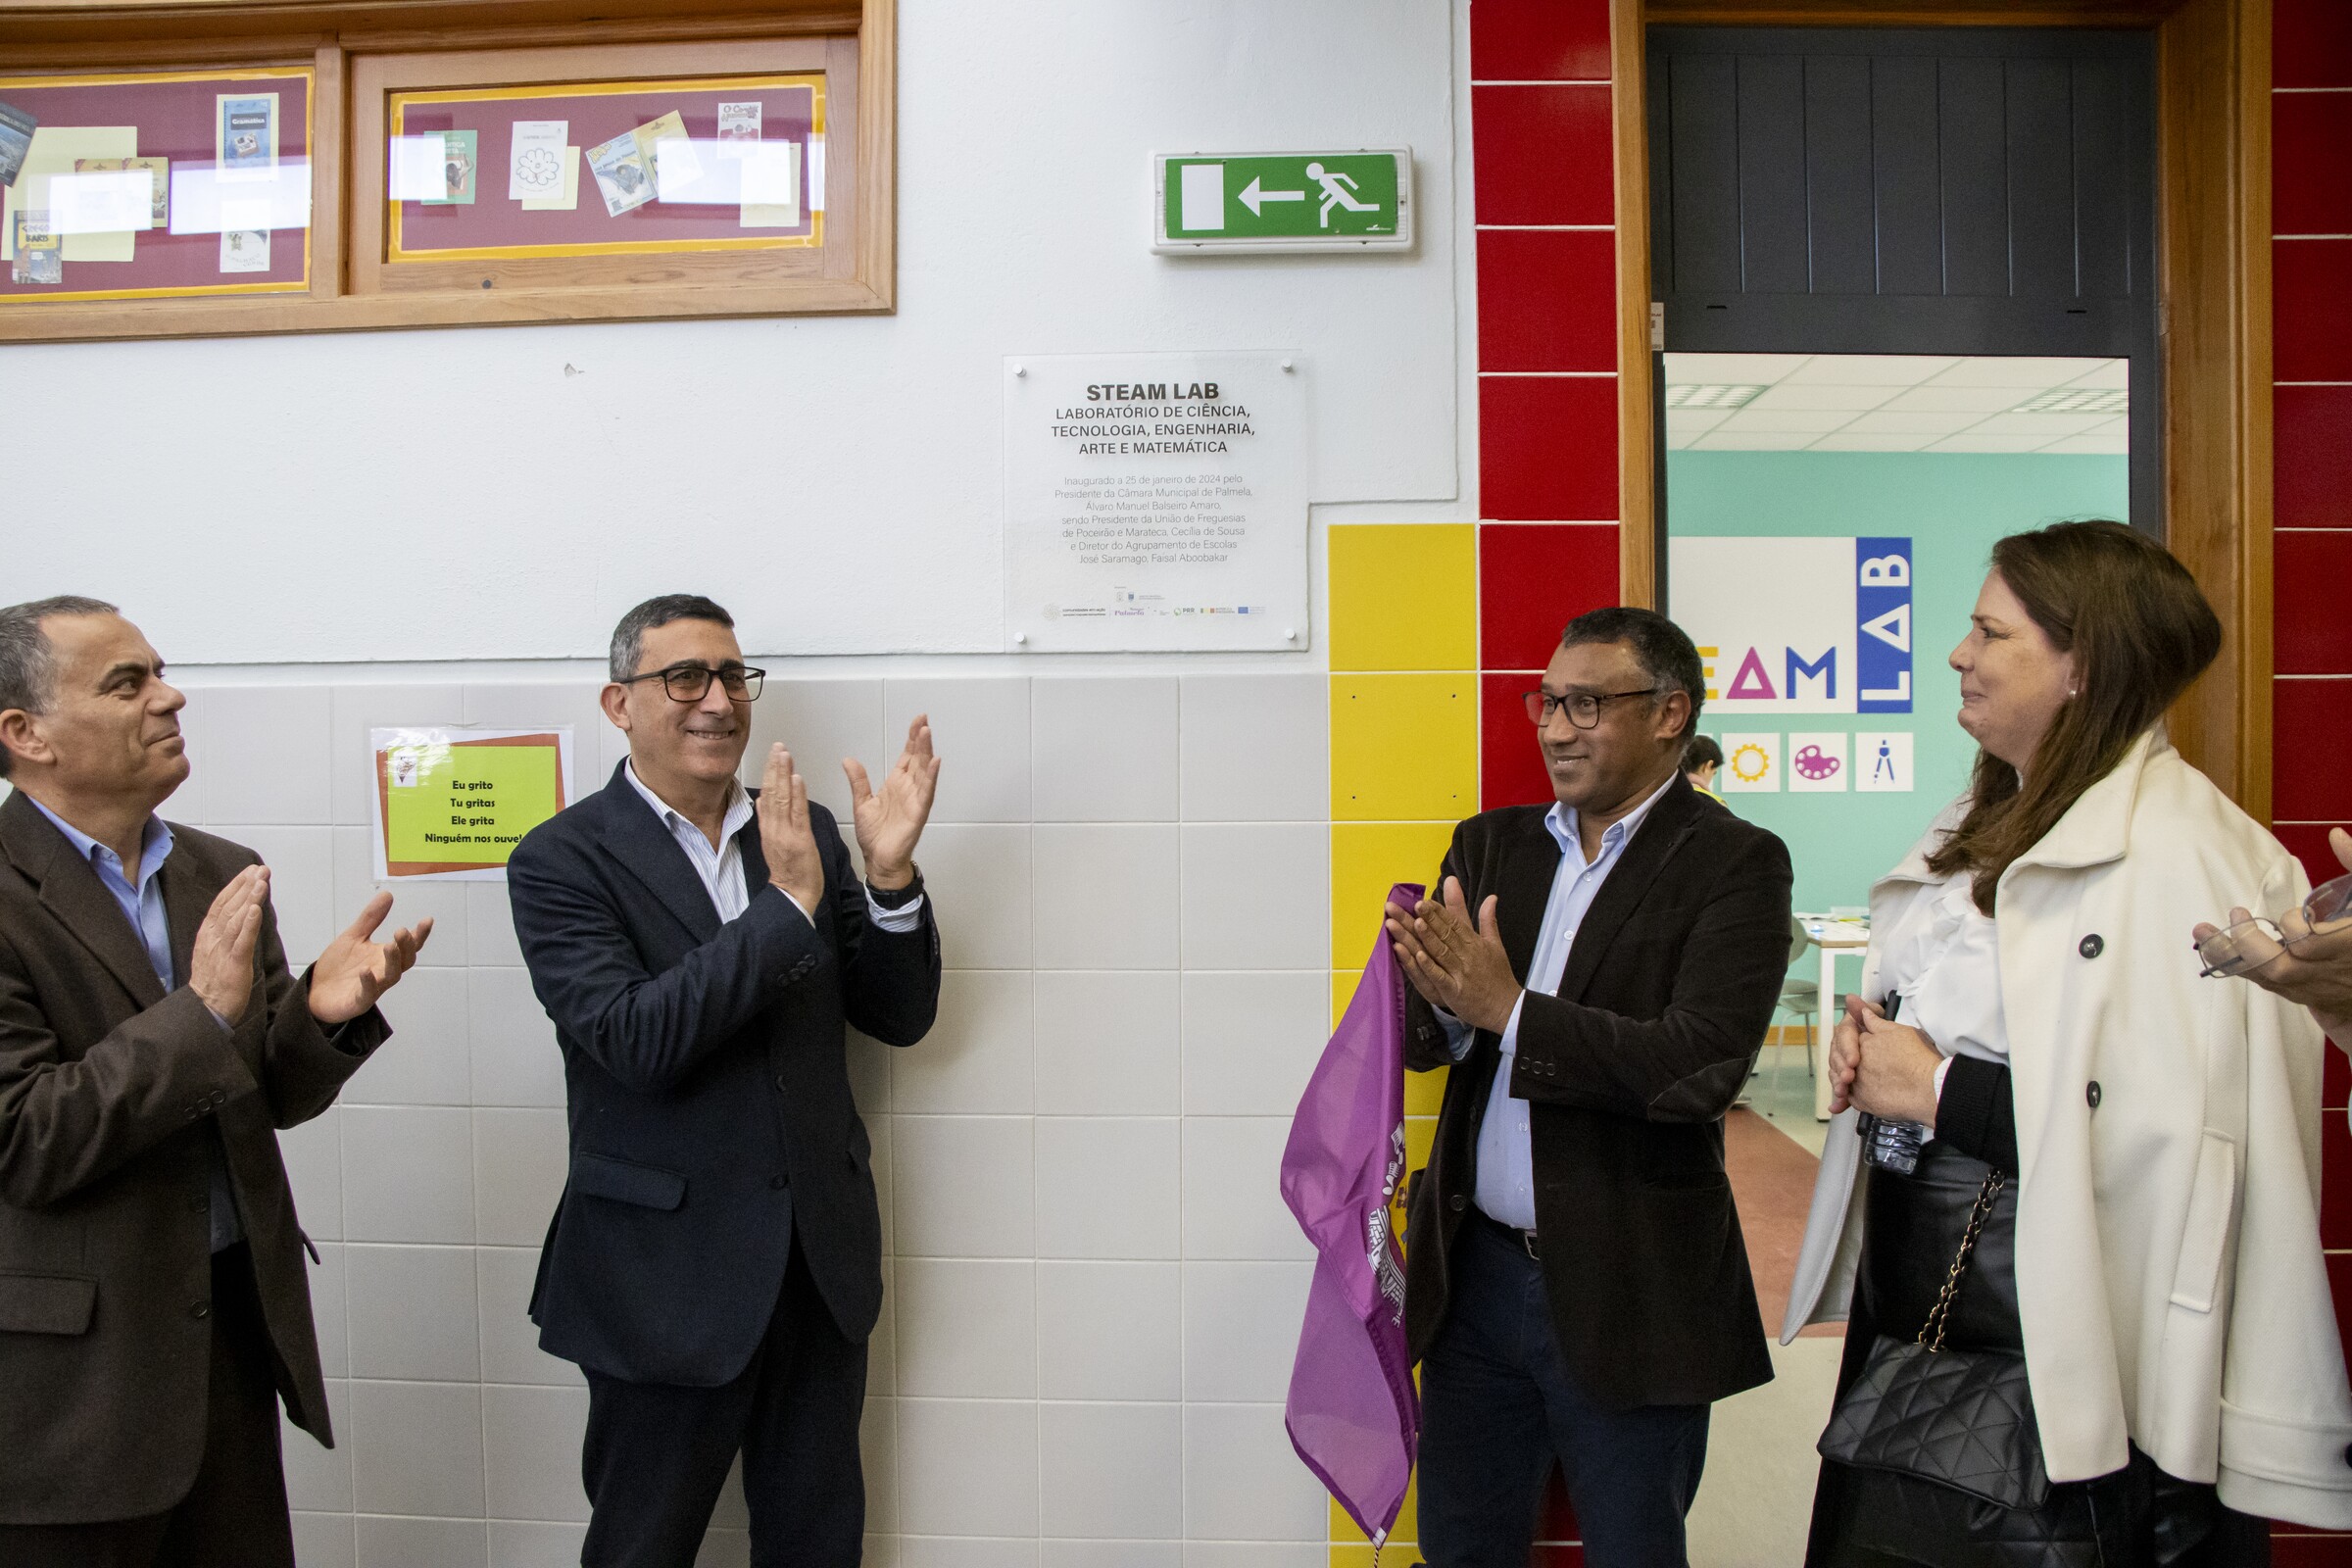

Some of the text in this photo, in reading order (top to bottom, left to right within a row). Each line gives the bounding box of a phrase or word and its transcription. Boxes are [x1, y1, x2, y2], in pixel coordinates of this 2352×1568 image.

[1087, 383, 1219, 401] STEAM LAB
[1056, 404, 1250, 419] LABORATÓRIO DE CIÊNCIA,
[1052, 423, 1254, 437] TECNOLOGIA, ENGENHARIA,
[1079, 441, 1228, 455] ARTE E MATEMÁTICA
[1064, 476, 1115, 487] Inaugurado
[1126, 476, 1136, 485] 25
[1139, 476, 1151, 485] de
[1152, 476, 1183, 486] janeiro
[1185, 475, 1196, 484] de
[1199, 474, 1221, 483] 2024
[1223, 474, 1243, 485] pelo
[1055, 487, 1253, 499] Presidente da Câmara Municipal de Palmela,
[1086, 501, 1113, 511] Álvaro
[1116, 502, 1150, 511] Manuel
[1190, 501, 1221, 511] Amaro,
[1062, 515, 1090, 524] sendo
[1091, 514, 1138, 524] Presidente
[1141, 514, 1152, 523] da
[1155, 514, 1181, 523] União
[1198, 514, 1247, 524] Freguesias
[1062, 528, 1075, 537] de
[1076, 527, 1115, 537] Poceirão
[1126, 527, 1168, 538] Marateca,
[1171, 526, 1200, 536] Cecília
[1203, 527, 1215, 536] de
[1217, 527, 1246, 536] Sousa
[1079, 542, 1109, 551] Diretor
[1111, 541, 1123, 550] do
[1125, 541, 1187, 552] Agrupamento
[1190, 540, 1200, 549] de
[1203, 540, 1237, 549] Escolas
[1079, 553, 1228, 565] José Saramago, Faisal Aboobakar
[1861, 555, 1910, 701] LAB
[453, 780, 493, 791] Eu grito
[451, 798, 495, 808] Tu gritas
[452, 815, 494, 826] Ele grita
[425, 833, 471, 844] Ninguém
